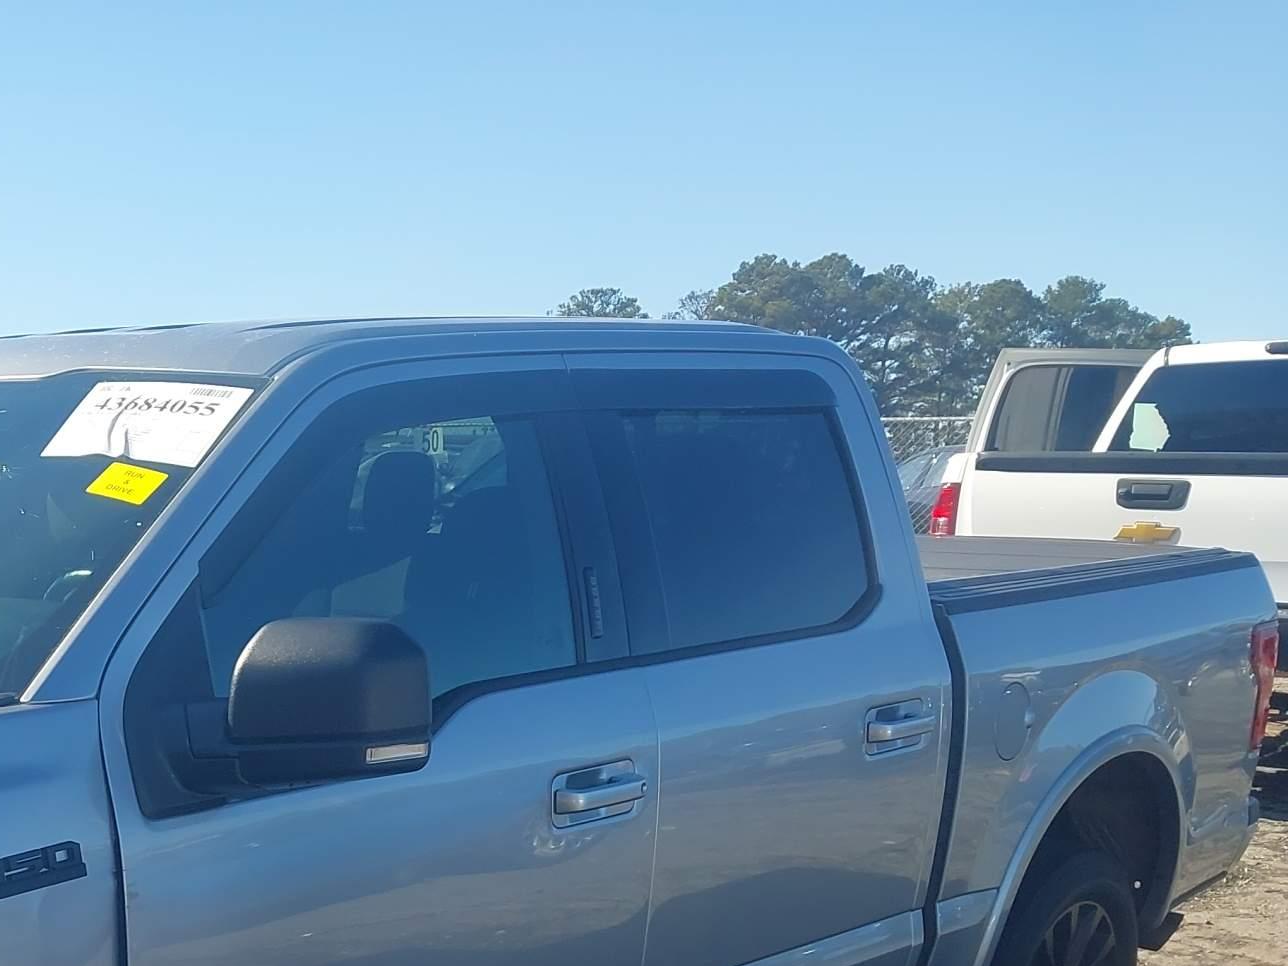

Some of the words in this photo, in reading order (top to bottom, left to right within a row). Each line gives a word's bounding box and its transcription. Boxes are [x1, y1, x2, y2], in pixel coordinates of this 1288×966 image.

[94, 396, 221, 416] 43684055
[124, 470, 146, 480] RUN
[105, 484, 136, 496] DRIVE
